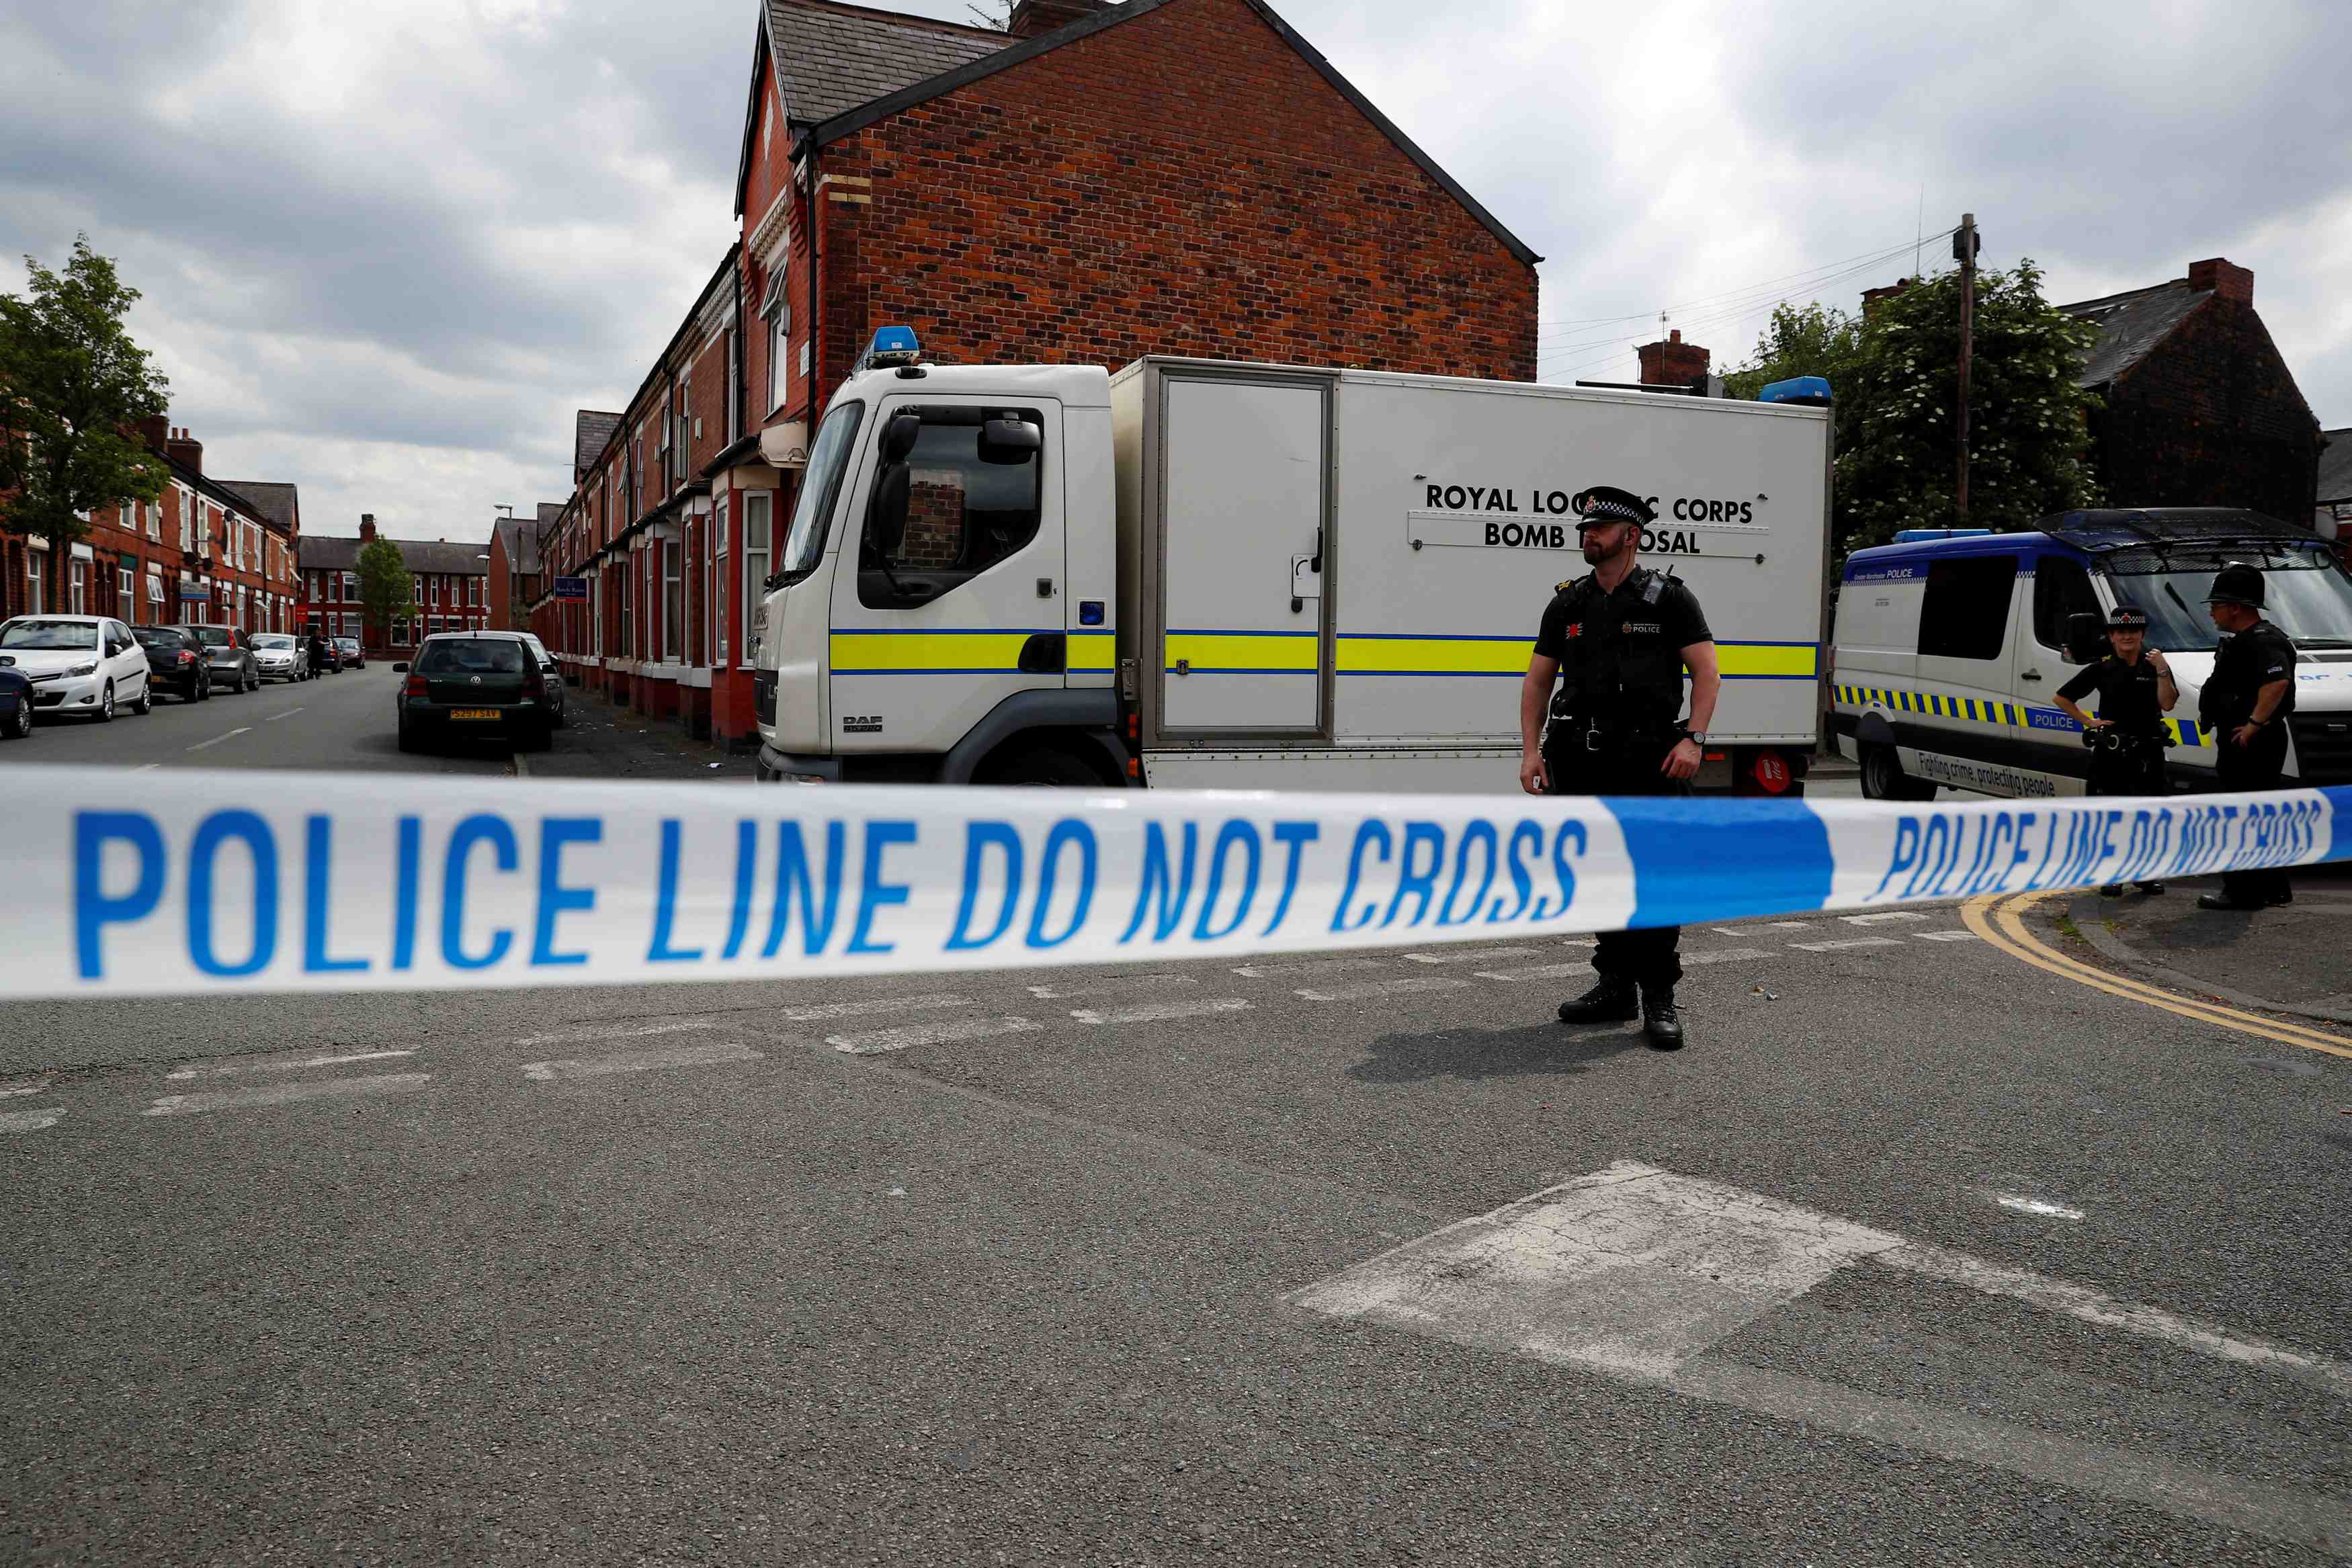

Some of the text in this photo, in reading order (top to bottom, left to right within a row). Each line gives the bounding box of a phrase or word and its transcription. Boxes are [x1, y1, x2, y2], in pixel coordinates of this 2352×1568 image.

[1427, 484, 1518, 512] ROYAL
[1673, 498, 1753, 523] CORPS
[1484, 523, 1565, 548] BOMB
[1887, 568, 1914, 579] POLICE
[844, 716, 882, 724] DAF
[2035, 714, 2074, 729] POLICE
[1919, 752, 1950, 780] Fighting
[1977, 767, 2022, 795] protecting
[2022, 775, 2056, 797] people
[1863, 799, 2322, 901] POLICE LINE DO NOT CROSS
[72, 807, 1588, 982] POLICE LINE DO NOT CROSS
